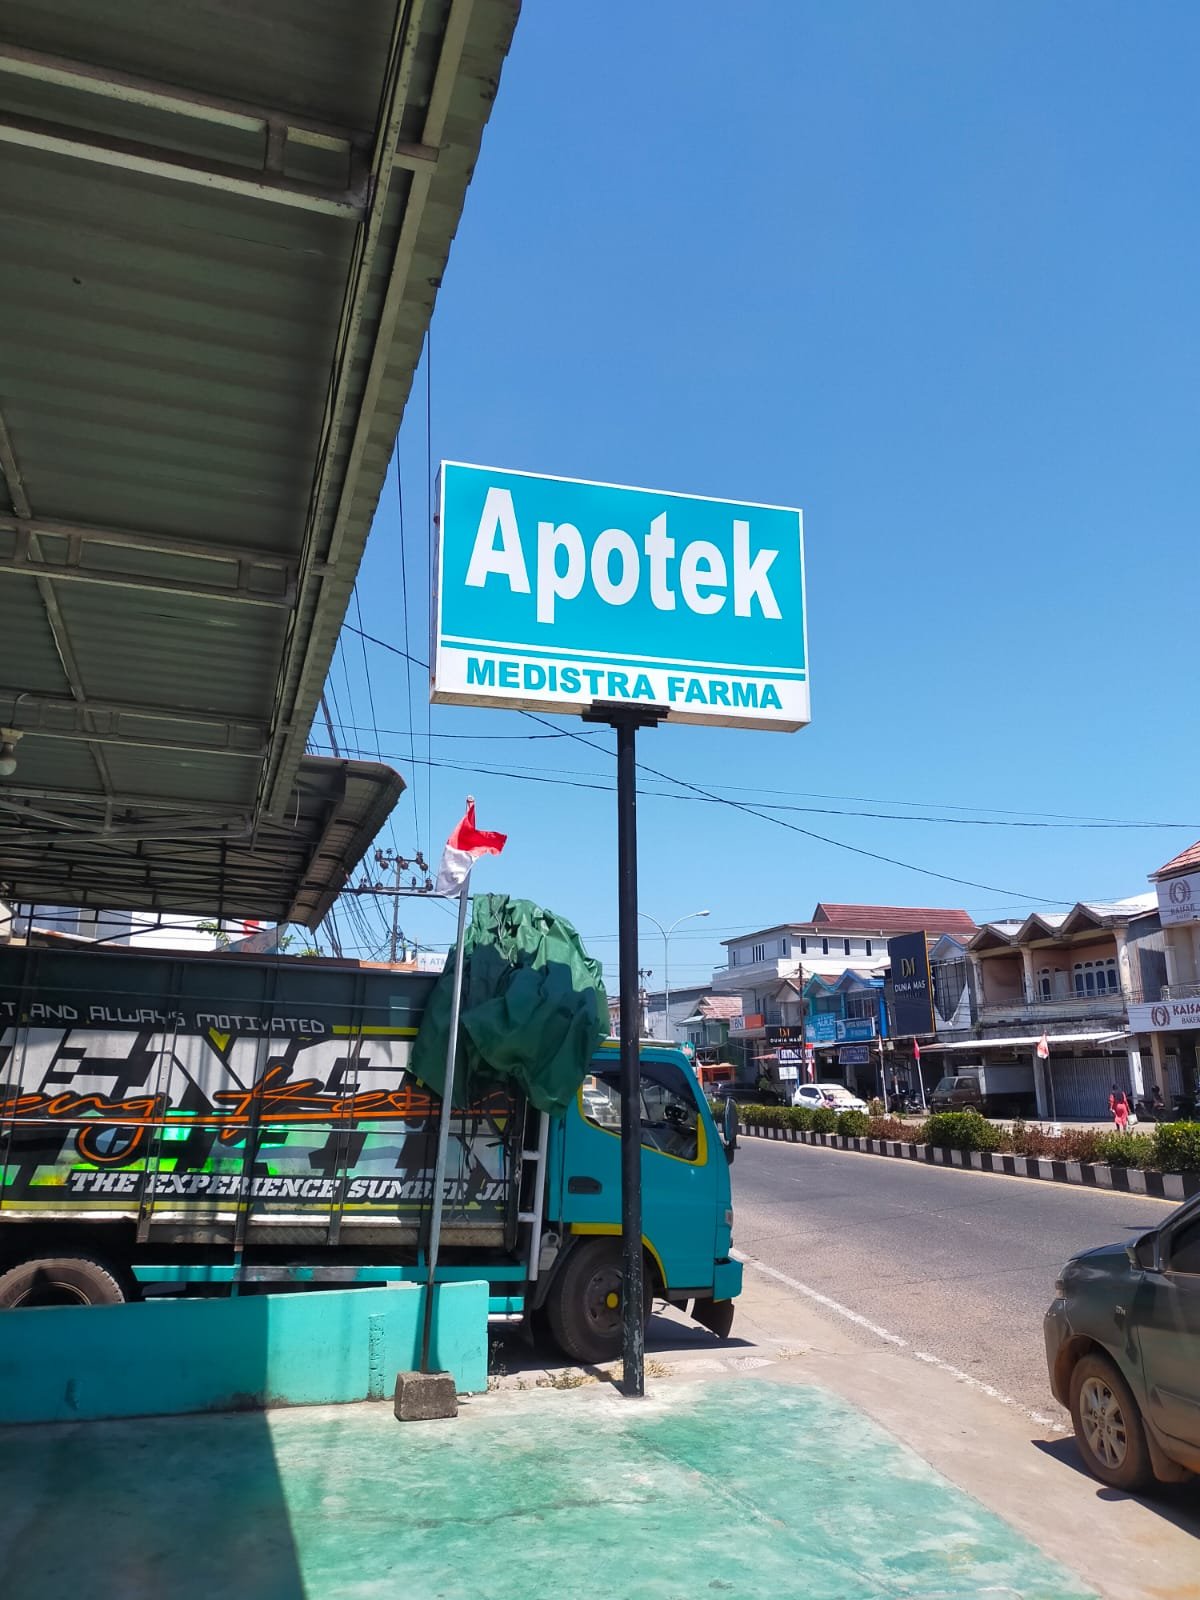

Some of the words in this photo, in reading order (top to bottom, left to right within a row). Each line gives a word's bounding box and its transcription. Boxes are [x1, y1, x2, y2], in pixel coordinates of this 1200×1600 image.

[464, 486, 783, 625] Apotek
[466, 657, 656, 701] MEDISTRA
[667, 676, 783, 710] FARMA
[894, 983, 912, 992] DUNIA
[913, 980, 926, 989] MAS
[30, 1003, 78, 1020] AND
[90, 1006, 186, 1027] ALLWAYS
[197, 1014, 325, 1034] MOTIVATED
[71, 1172, 140, 1193] THE
[145, 1174, 342, 1199] EXPERIENCE
